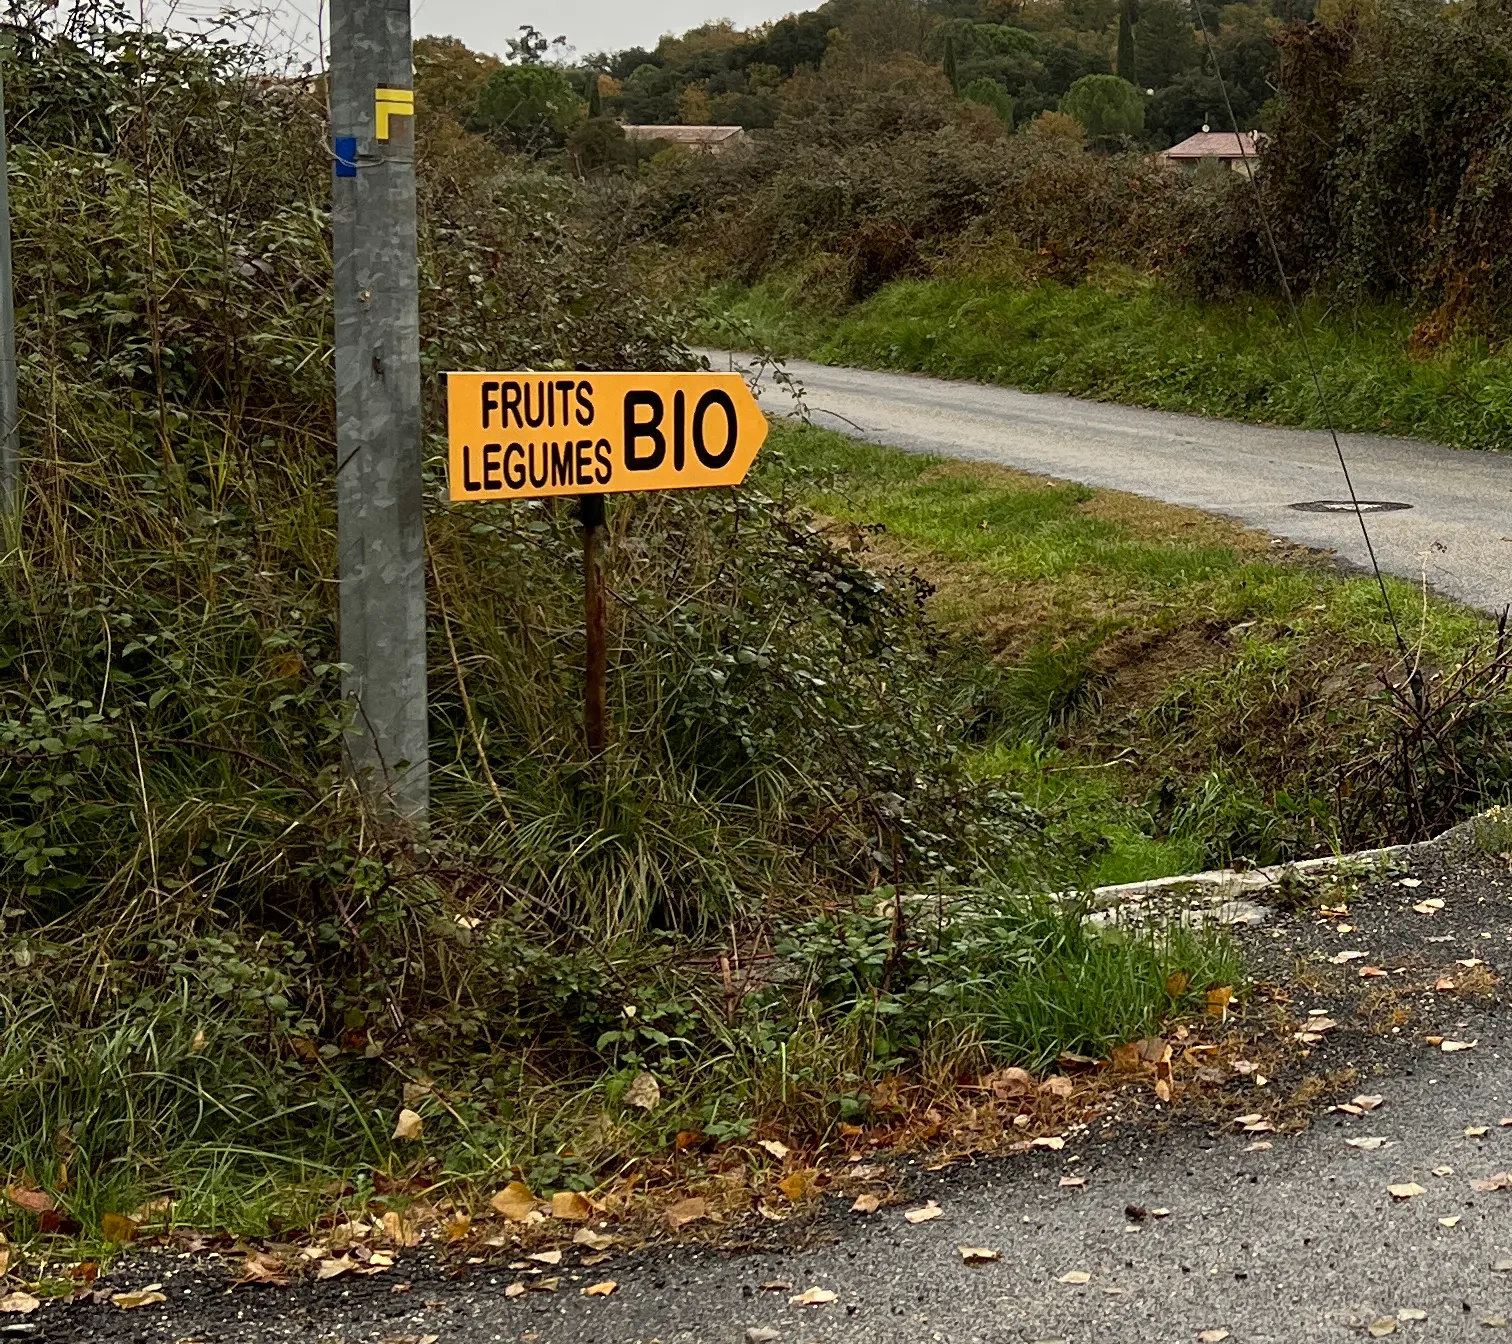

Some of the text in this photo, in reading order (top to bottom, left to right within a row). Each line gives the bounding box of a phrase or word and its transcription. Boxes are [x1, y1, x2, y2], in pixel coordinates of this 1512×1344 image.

[481, 380, 595, 429] FRUITS
[623, 389, 738, 472] BIO
[463, 438, 612, 492] LEGUMES
